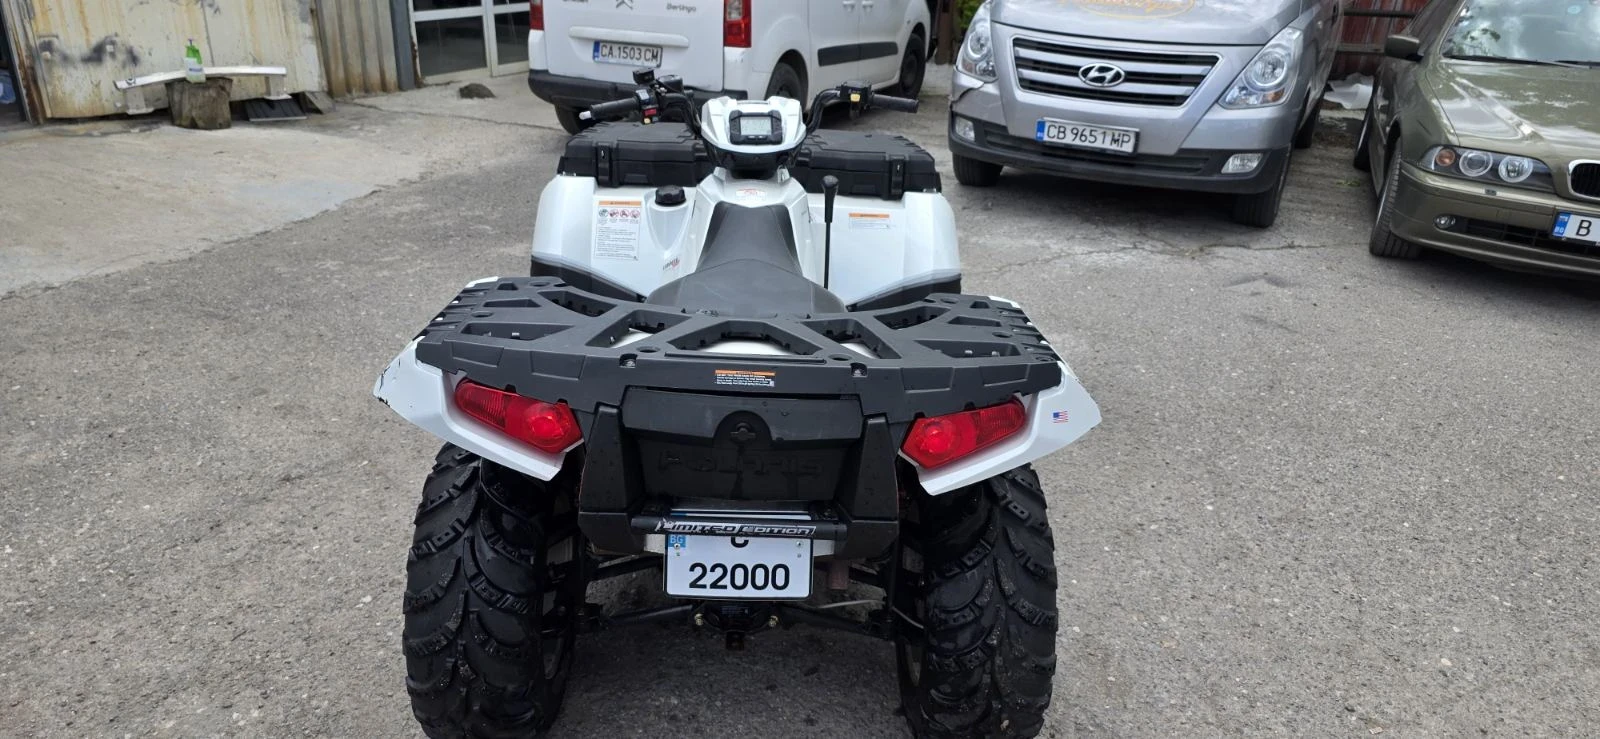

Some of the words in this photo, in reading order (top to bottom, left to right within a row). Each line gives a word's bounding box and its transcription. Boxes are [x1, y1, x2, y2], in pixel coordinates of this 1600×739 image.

[666, 3, 697, 13] Berlingo
[1046, 124, 1067, 140] CB
[1070, 127, 1107, 144] 9651
[670, 534, 684, 544] BG
[688, 562, 791, 591] 22000
